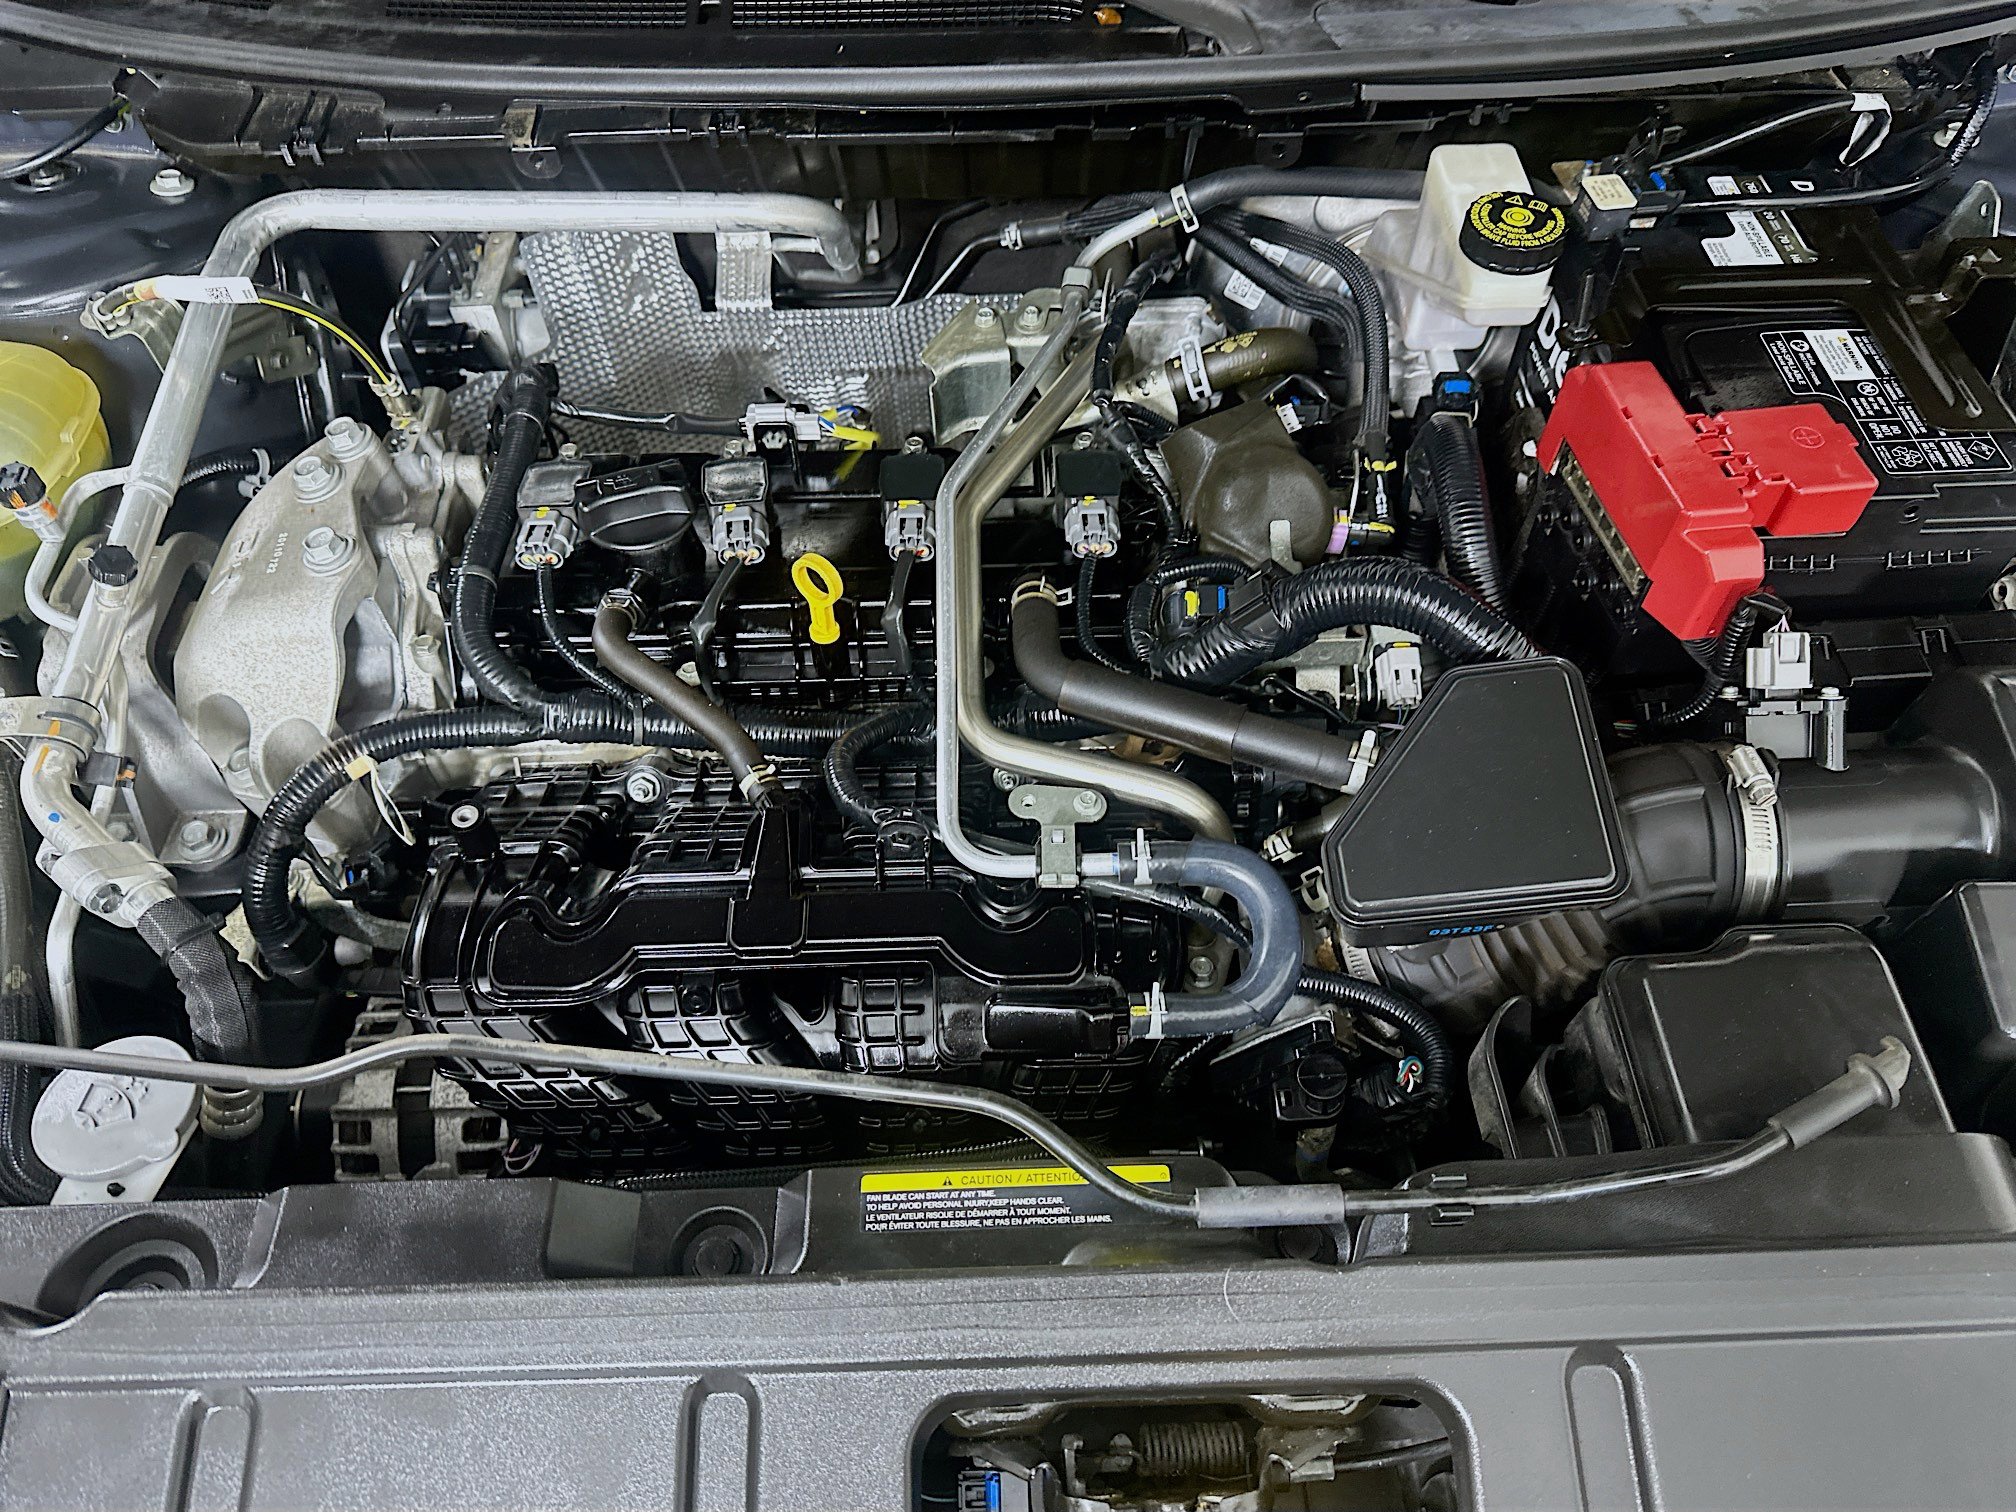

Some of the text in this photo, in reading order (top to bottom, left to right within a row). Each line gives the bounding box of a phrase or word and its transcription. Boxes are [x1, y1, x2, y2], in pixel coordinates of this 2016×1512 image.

[1763, 211, 1775, 219] 20
[1500, 238, 1520, 246] FLUID
[1521, 238, 1540, 246] FROM
[1507, 232, 1534, 240] BEFORE
[1746, 221, 1773, 258] NON-SPILLABLE
[1775, 340, 1806, 385] NON-SPILLABLE
[1805, 353, 1816, 366] READ
[1842, 342, 1863, 371] WARNING:
[1530, 341, 1550, 388] POWER
[1869, 423, 1884, 439] OPEN.
[1879, 425, 1893, 436] NOT
[1890, 426, 1901, 434] DO
[961, 1174, 1012, 1185] CAUTION
[1026, 1172, 1083, 1182] ATTENTIO
[866, 1194, 881, 1202] FAN
[882, 1193, 907, 1201] BLADE
[908, 1192, 924, 1200] CAN
[960, 1190, 976, 1198] ANY
[899, 1202, 922, 1210] AVOID
[923, 1200, 963, 1209] PERSONAL
[1010, 1197, 1036, 1205] HANDS
[1038, 1196, 1064, 1205] CLEAR.
[866, 1206, 1072, 1222] LE VENTILATEUR RISQUE DE DÉMARRER À TOUT MOMENT.
[866, 1223, 887, 1231] POUR
[889, 1221, 914, 1230] ÉVITER
[915, 1221, 940, 1229] TOUTE
[941, 1220, 982, 1228] BLESSURE,
[995, 1218, 1010, 1226] PAS
[1023, 1216, 1070, 1225] APPROCHER
[1087, 1215, 1112, 1223] MAINS.
